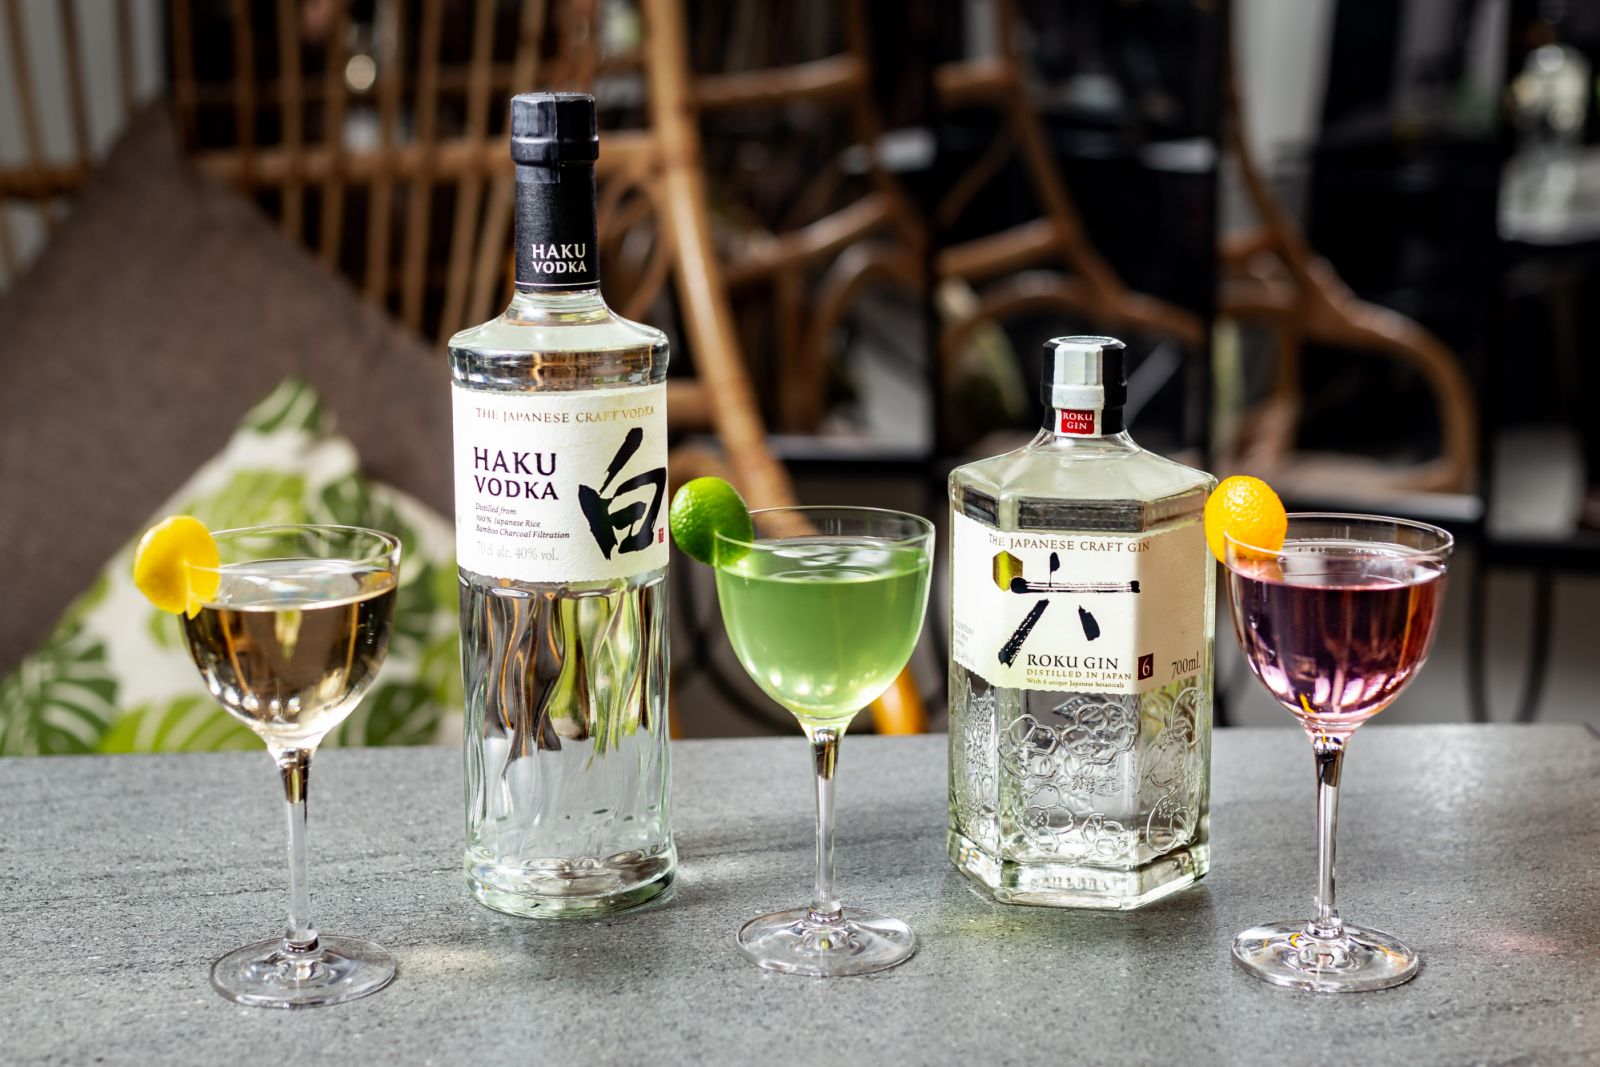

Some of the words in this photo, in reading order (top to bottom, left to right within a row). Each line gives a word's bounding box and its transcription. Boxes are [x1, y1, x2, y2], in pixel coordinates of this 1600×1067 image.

[532, 243, 586, 259] HAKU
[532, 261, 587, 274] VODKA
[476, 408, 497, 420] THE
[503, 411, 570, 423] JAPANESE
[576, 410, 618, 422] CRAFT
[622, 406, 655, 418] VODKA
[1063, 412, 1093, 421] ROKU
[1067, 422, 1087, 430] GIN
[474, 447, 556, 476] HAKU
[475, 475, 559, 500] VODKA
[578, 427, 666, 560] 白
[475, 503, 499, 514] Distilled
[499, 506, 517, 516] from
[476, 514, 492, 523] 100%
[494, 517, 524, 527] Japanese
[525, 520, 541, 528] Rice
[476, 524, 499, 535] Bamboo
[499, 528, 531, 538] Charcoal
[532, 531, 570, 539] Filtration
[988, 534, 1005, 547] THE
[1010, 538, 1075, 550] JAPANESE
[1080, 541, 1123, 552] CRAFT
[1127, 542, 1150, 552] GIN
[514, 547, 538, 560] 40%
[541, 547, 559, 561] vol.
[1026, 654, 1079, 668] ROKU
[1083, 656, 1119, 670] GIN
[1026, 668, 1082, 678] DISTILLED
[1102, 673, 1132, 681] JAPAN
[1048, 680, 1068, 688] unique
[1069, 680, 1094, 689] Japanese
